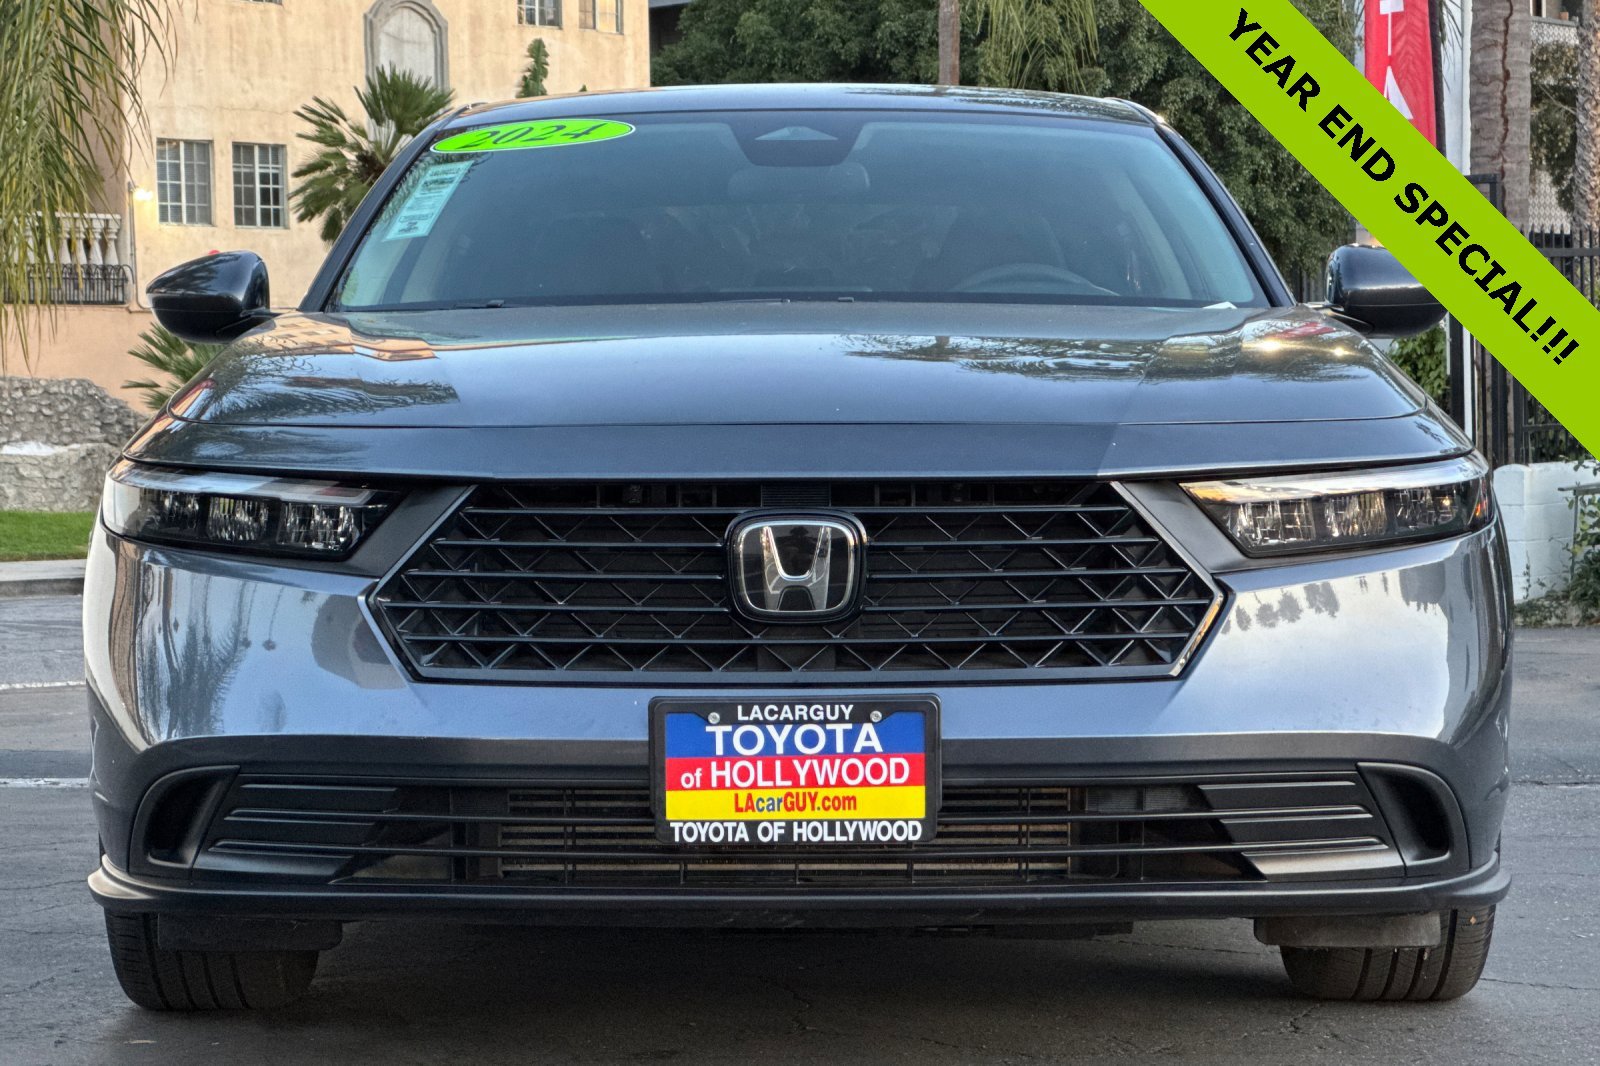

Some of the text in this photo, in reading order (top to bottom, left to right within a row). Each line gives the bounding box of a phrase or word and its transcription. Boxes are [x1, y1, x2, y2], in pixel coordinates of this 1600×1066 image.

[457, 123, 608, 149] 2024
[737, 704, 854, 721] LACARGUY
[705, 722, 884, 756] TOYOTA
[680, 757, 910, 788] of HOLLYWOOD
[734, 791, 857, 813] LAcarGUY.com
[670, 820, 922, 843] TOYOTA OF HOLLYWOOD
